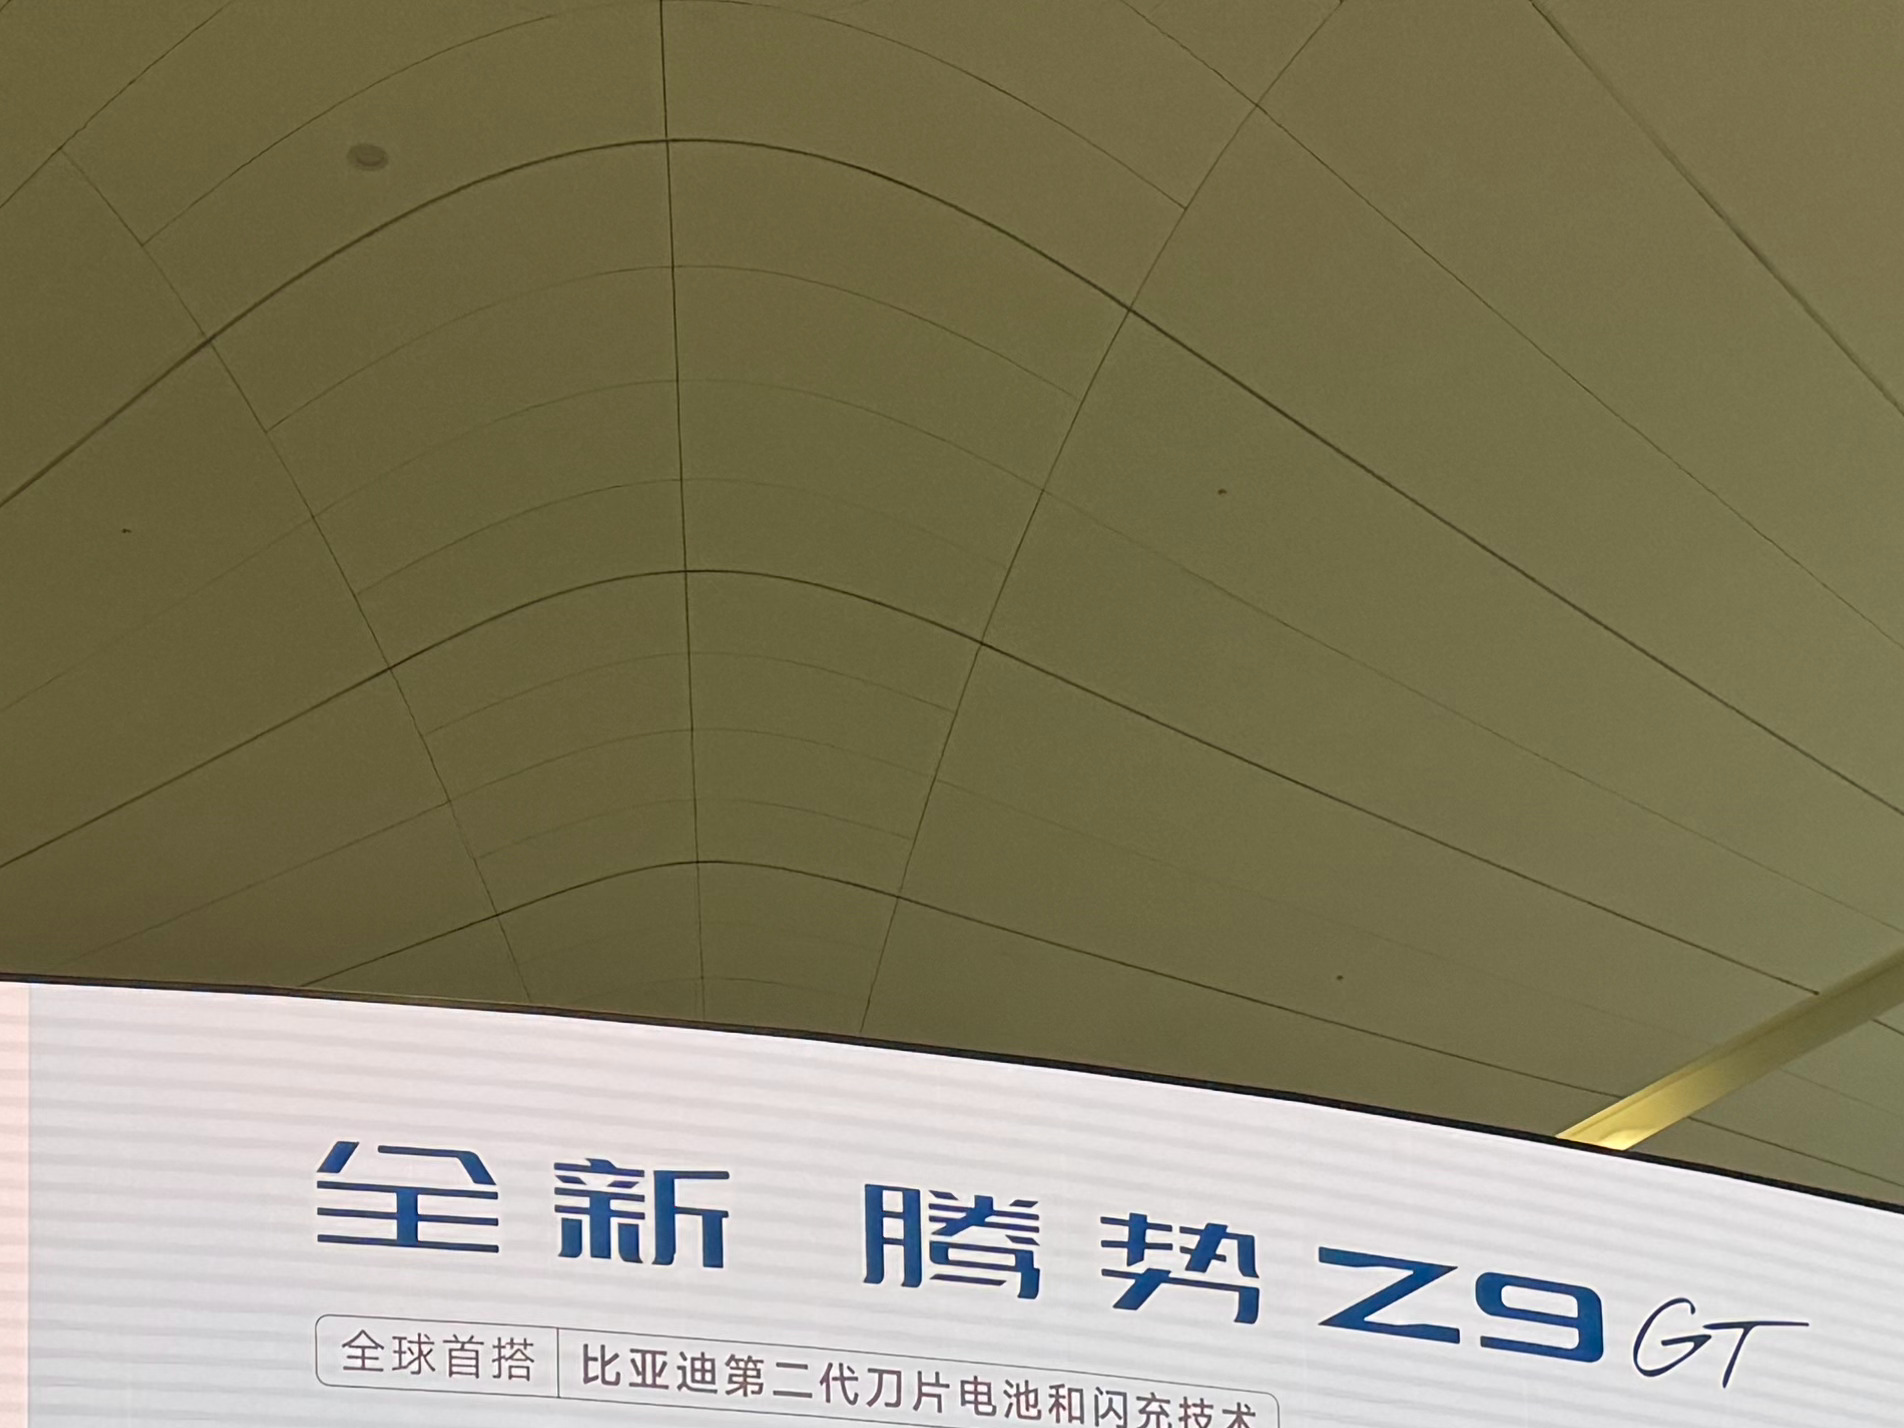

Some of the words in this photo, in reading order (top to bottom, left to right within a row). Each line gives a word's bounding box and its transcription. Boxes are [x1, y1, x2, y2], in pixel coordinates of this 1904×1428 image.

[316, 1140, 734, 1271] 全新
[339, 1327, 538, 1387] 全球首搭
